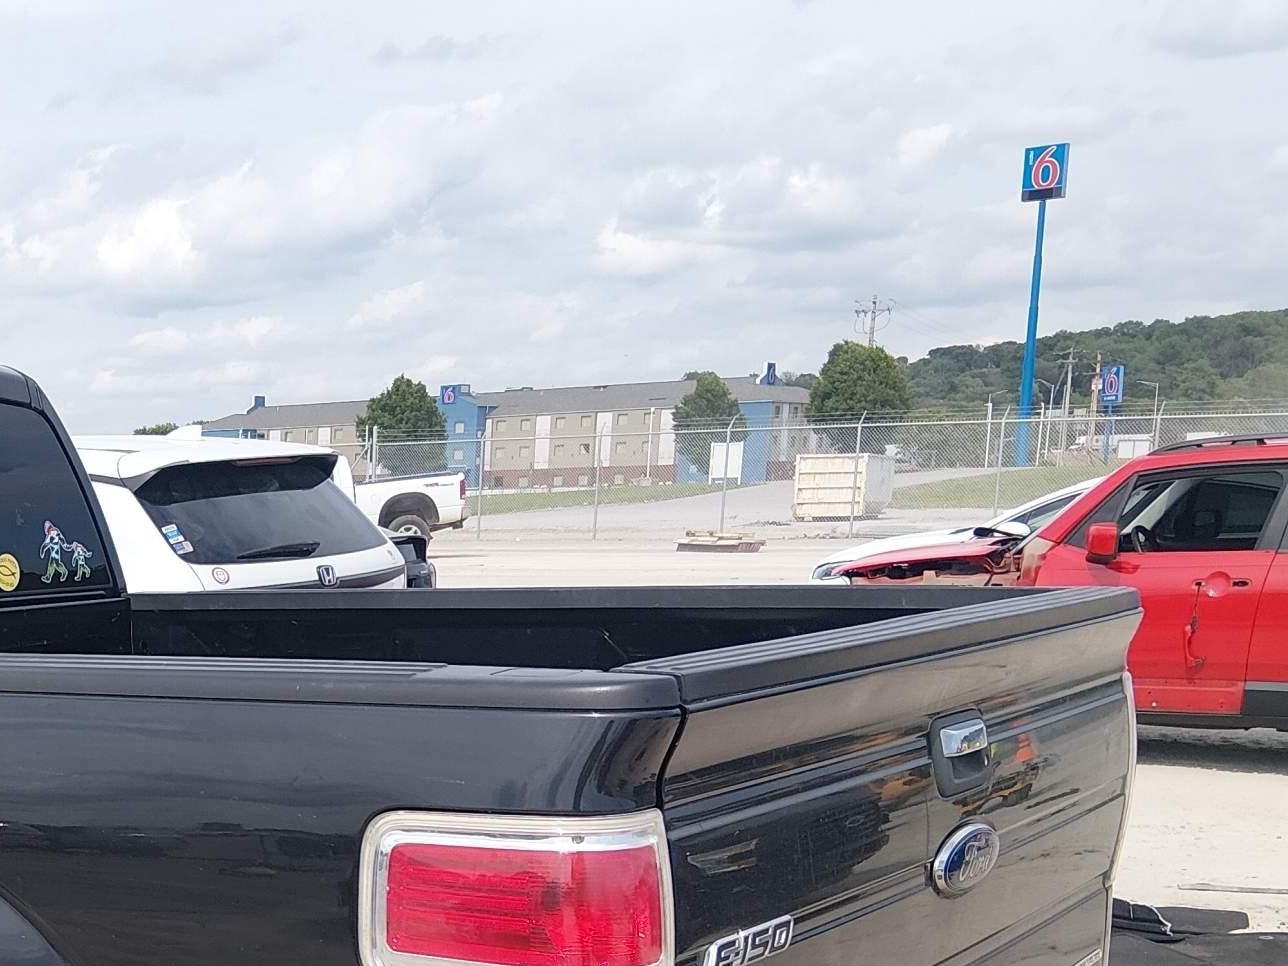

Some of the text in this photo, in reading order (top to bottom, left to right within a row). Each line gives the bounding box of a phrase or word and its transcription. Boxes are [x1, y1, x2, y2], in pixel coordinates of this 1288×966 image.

[1031, 146, 1061, 189] 6
[444, 387, 455, 404] 6
[1105, 367, 1118, 395] 6
[959, 839, 992, 882] Ford
